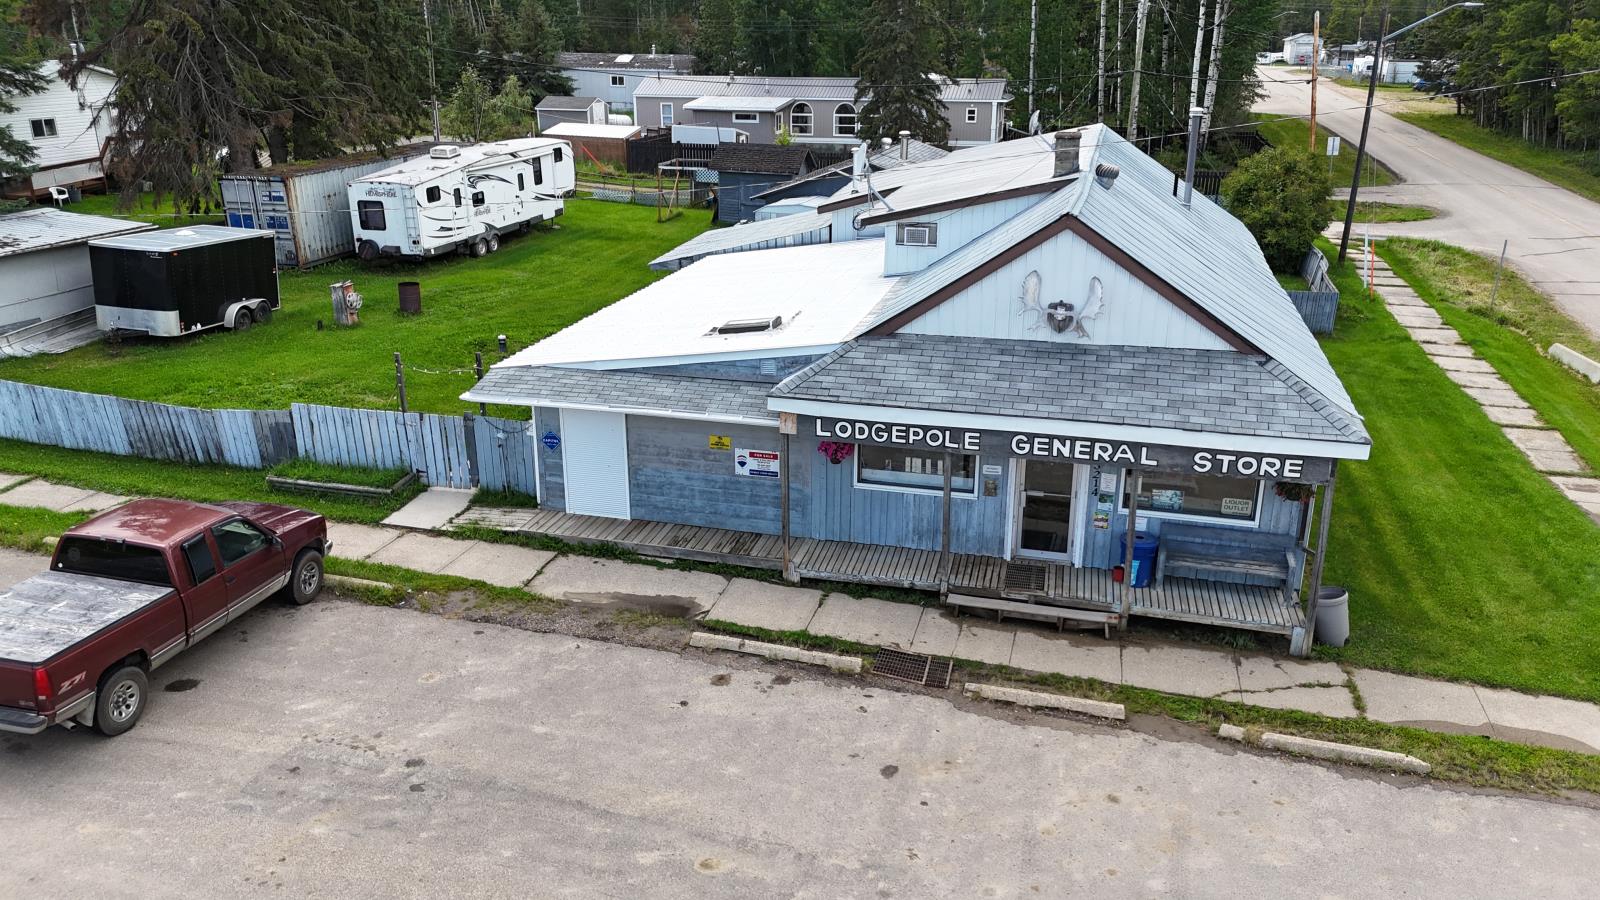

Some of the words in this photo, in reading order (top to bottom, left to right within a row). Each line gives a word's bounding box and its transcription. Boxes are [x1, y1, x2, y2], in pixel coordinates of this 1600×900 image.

[815, 418, 981, 451] LODGEPOLE
[1011, 434, 1158, 466] GENERAL
[1192, 451, 1304, 478] STORE
[58, 671, 88, 696] Z71
